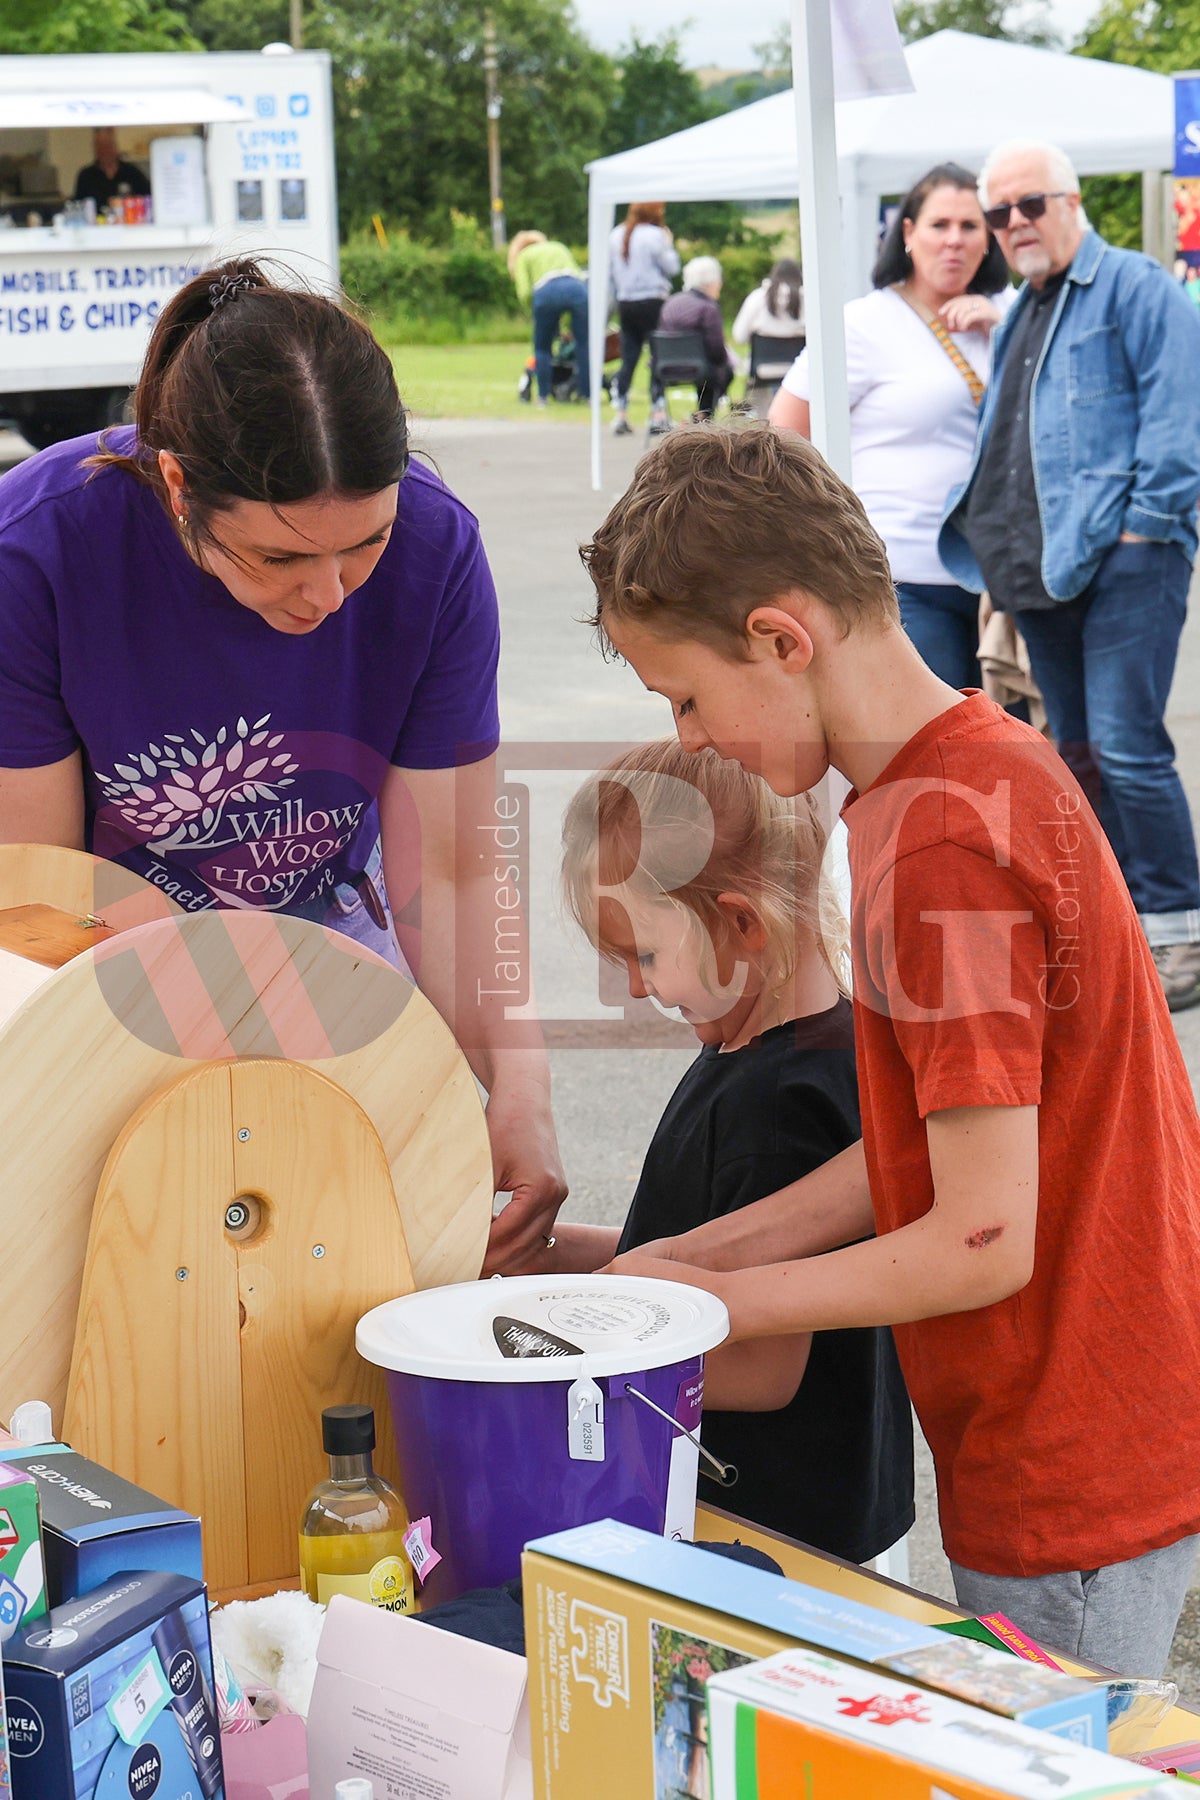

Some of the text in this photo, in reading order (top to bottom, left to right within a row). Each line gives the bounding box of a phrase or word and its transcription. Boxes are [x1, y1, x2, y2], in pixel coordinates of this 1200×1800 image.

[60, 304, 75, 332] &
[226, 798, 364, 842] Willow
[583, 1422, 593, 1455] 023591
[382, 1594, 395, 1602] BODY
[595, 1625, 607, 1672] PIECE
[605, 1620, 622, 1686] CORNER
[171, 1659, 193, 1686] NIVEA
[557, 1591, 572, 1734] Village Wedding
[72, 1680, 88, 1698] JUST
[175, 1669, 192, 1690] MEN
[73, 1694, 89, 1709] FOR
[74, 1705, 90, 1720] YOU
[134, 1694, 147, 1715] 5
[130, 1757, 159, 1784] NIVEA
[135, 1771, 156, 1793] MEN
